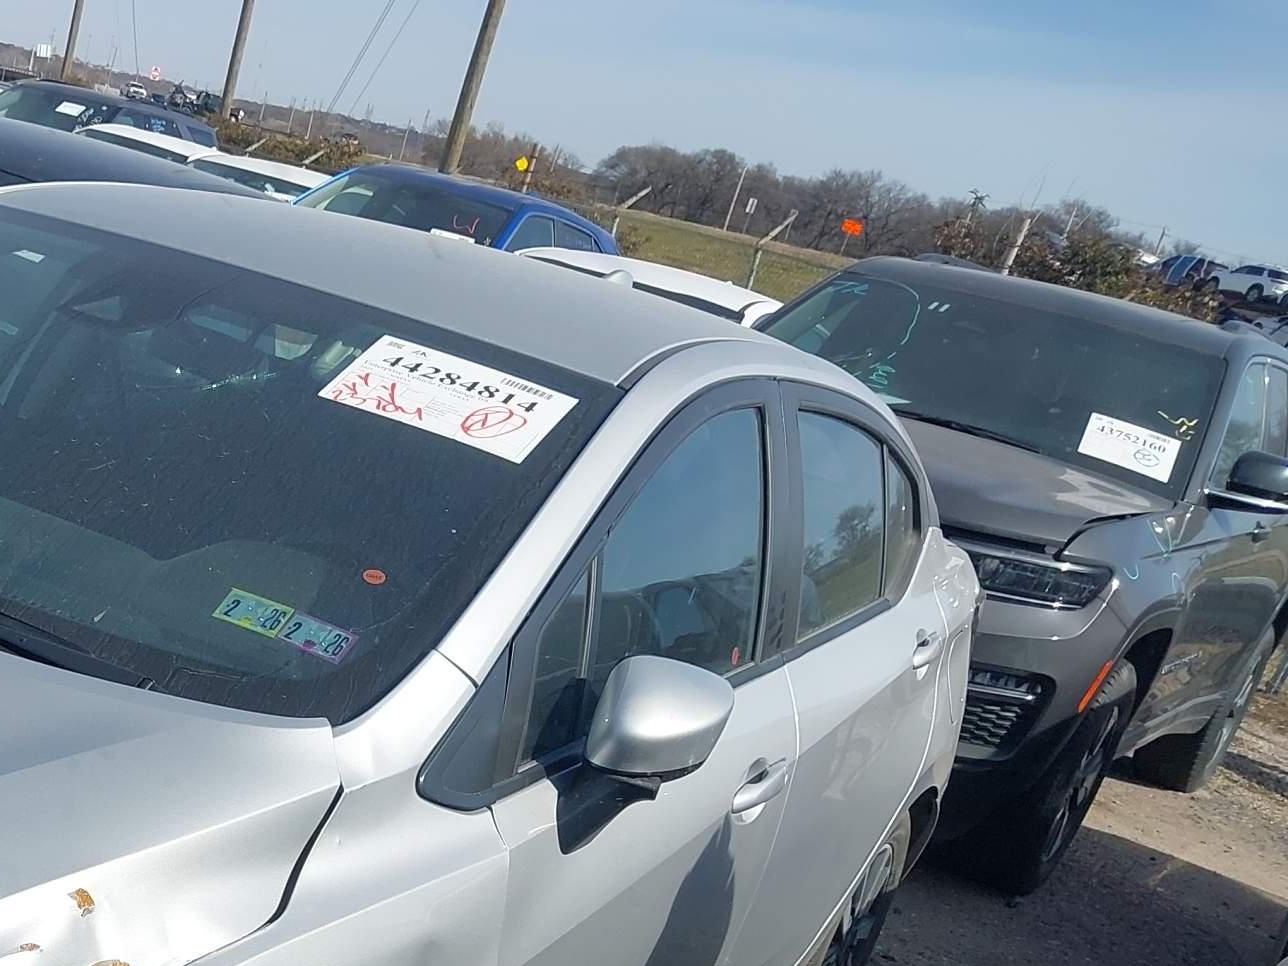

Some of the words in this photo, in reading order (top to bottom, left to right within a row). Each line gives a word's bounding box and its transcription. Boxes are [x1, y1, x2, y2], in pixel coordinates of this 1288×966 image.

[382, 356, 540, 414] 44284814
[1096, 424, 1167, 454] 43752160
[223, 599, 241, 617] 2
[263, 609, 286, 630] 26
[285, 621, 302, 640] 2
[324, 633, 349, 656] 26
